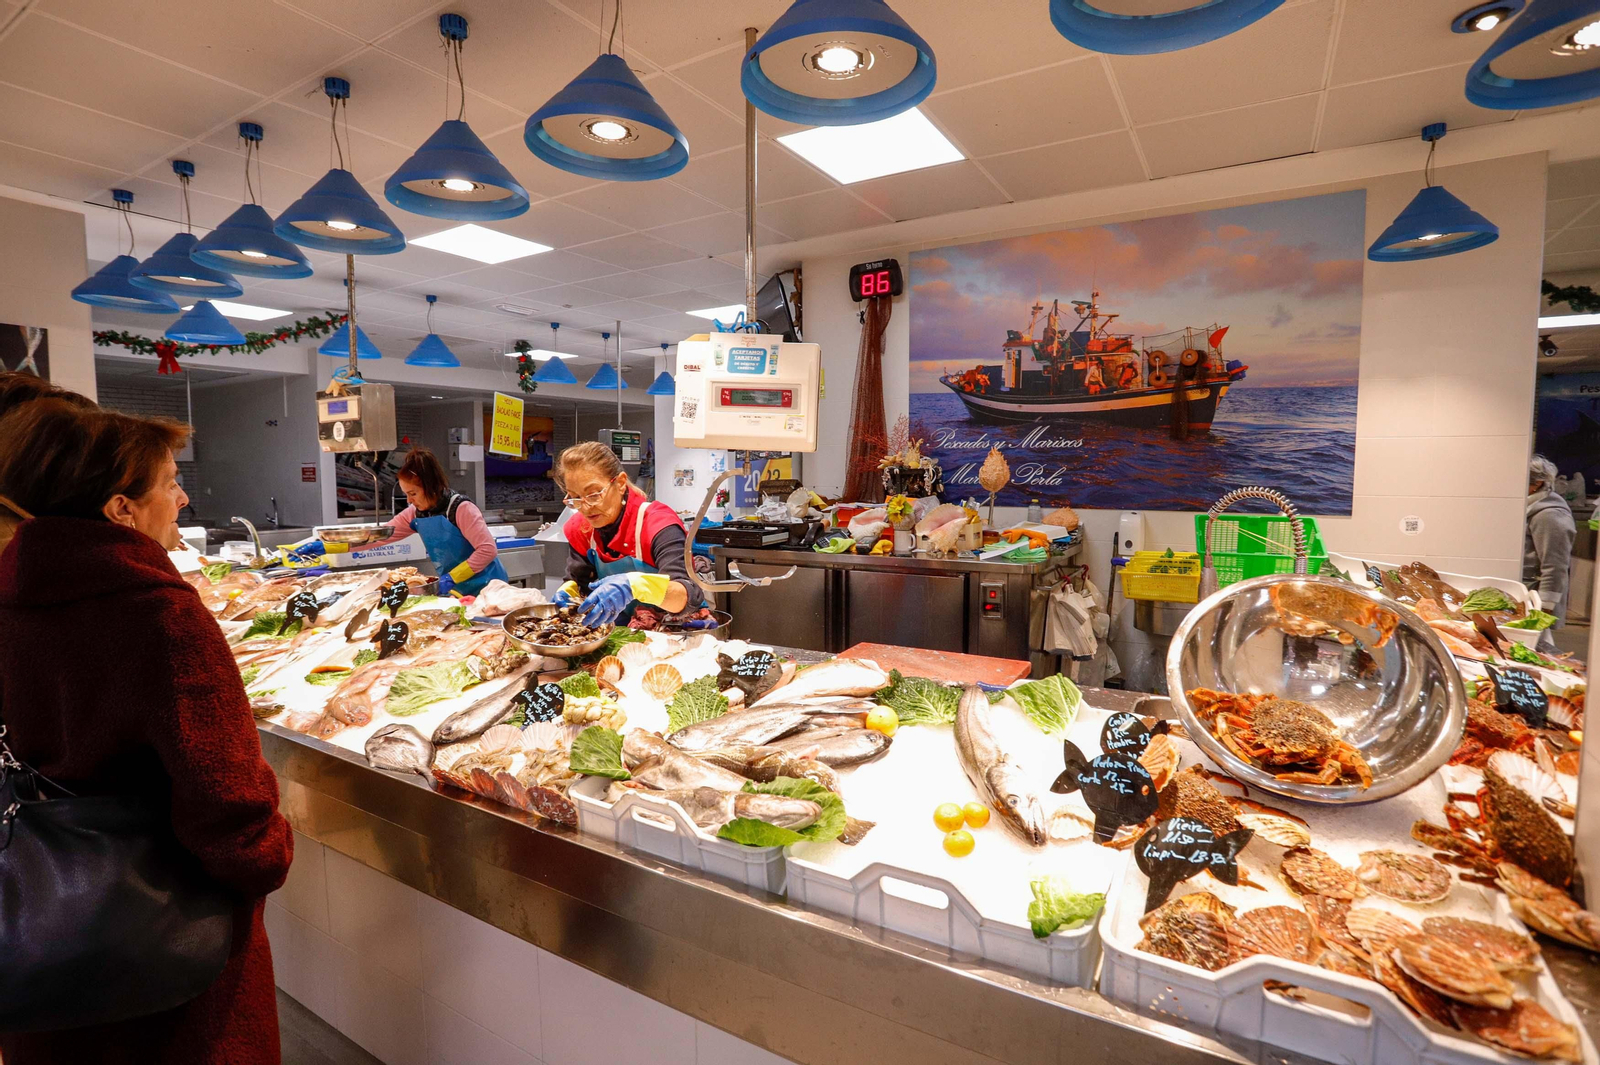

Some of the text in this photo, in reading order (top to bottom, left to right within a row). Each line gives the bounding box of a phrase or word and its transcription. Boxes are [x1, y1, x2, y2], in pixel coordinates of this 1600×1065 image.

[861, 271, 889, 296] 86
[495, 420, 508, 429] PIEZA
[926, 427, 990, 449] Pescados
[1009, 425, 1084, 449] Mariscos
[1011, 462, 1067, 486] Perla
